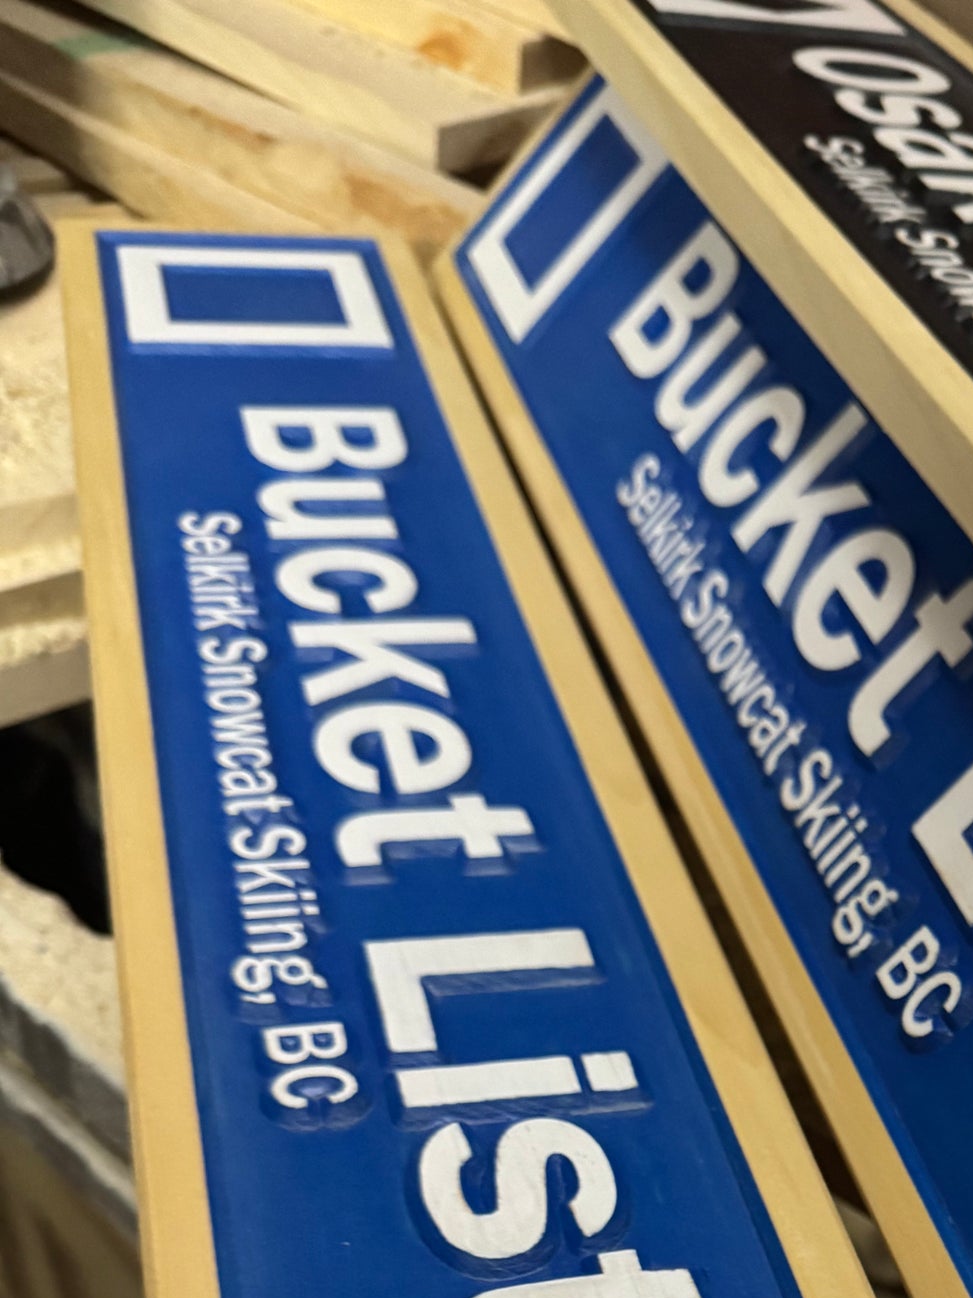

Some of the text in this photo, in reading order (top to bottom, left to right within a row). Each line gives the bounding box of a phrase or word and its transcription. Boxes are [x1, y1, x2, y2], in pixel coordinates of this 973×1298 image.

[803, 135, 928, 223] Selkirk
[179, 512, 358, 1108] Selkirk Snowcat Skiing, BC
[240, 406, 535, 867] Bucket
[617, 454, 961, 1037] Selkirk Snowcat Skiing, BC
